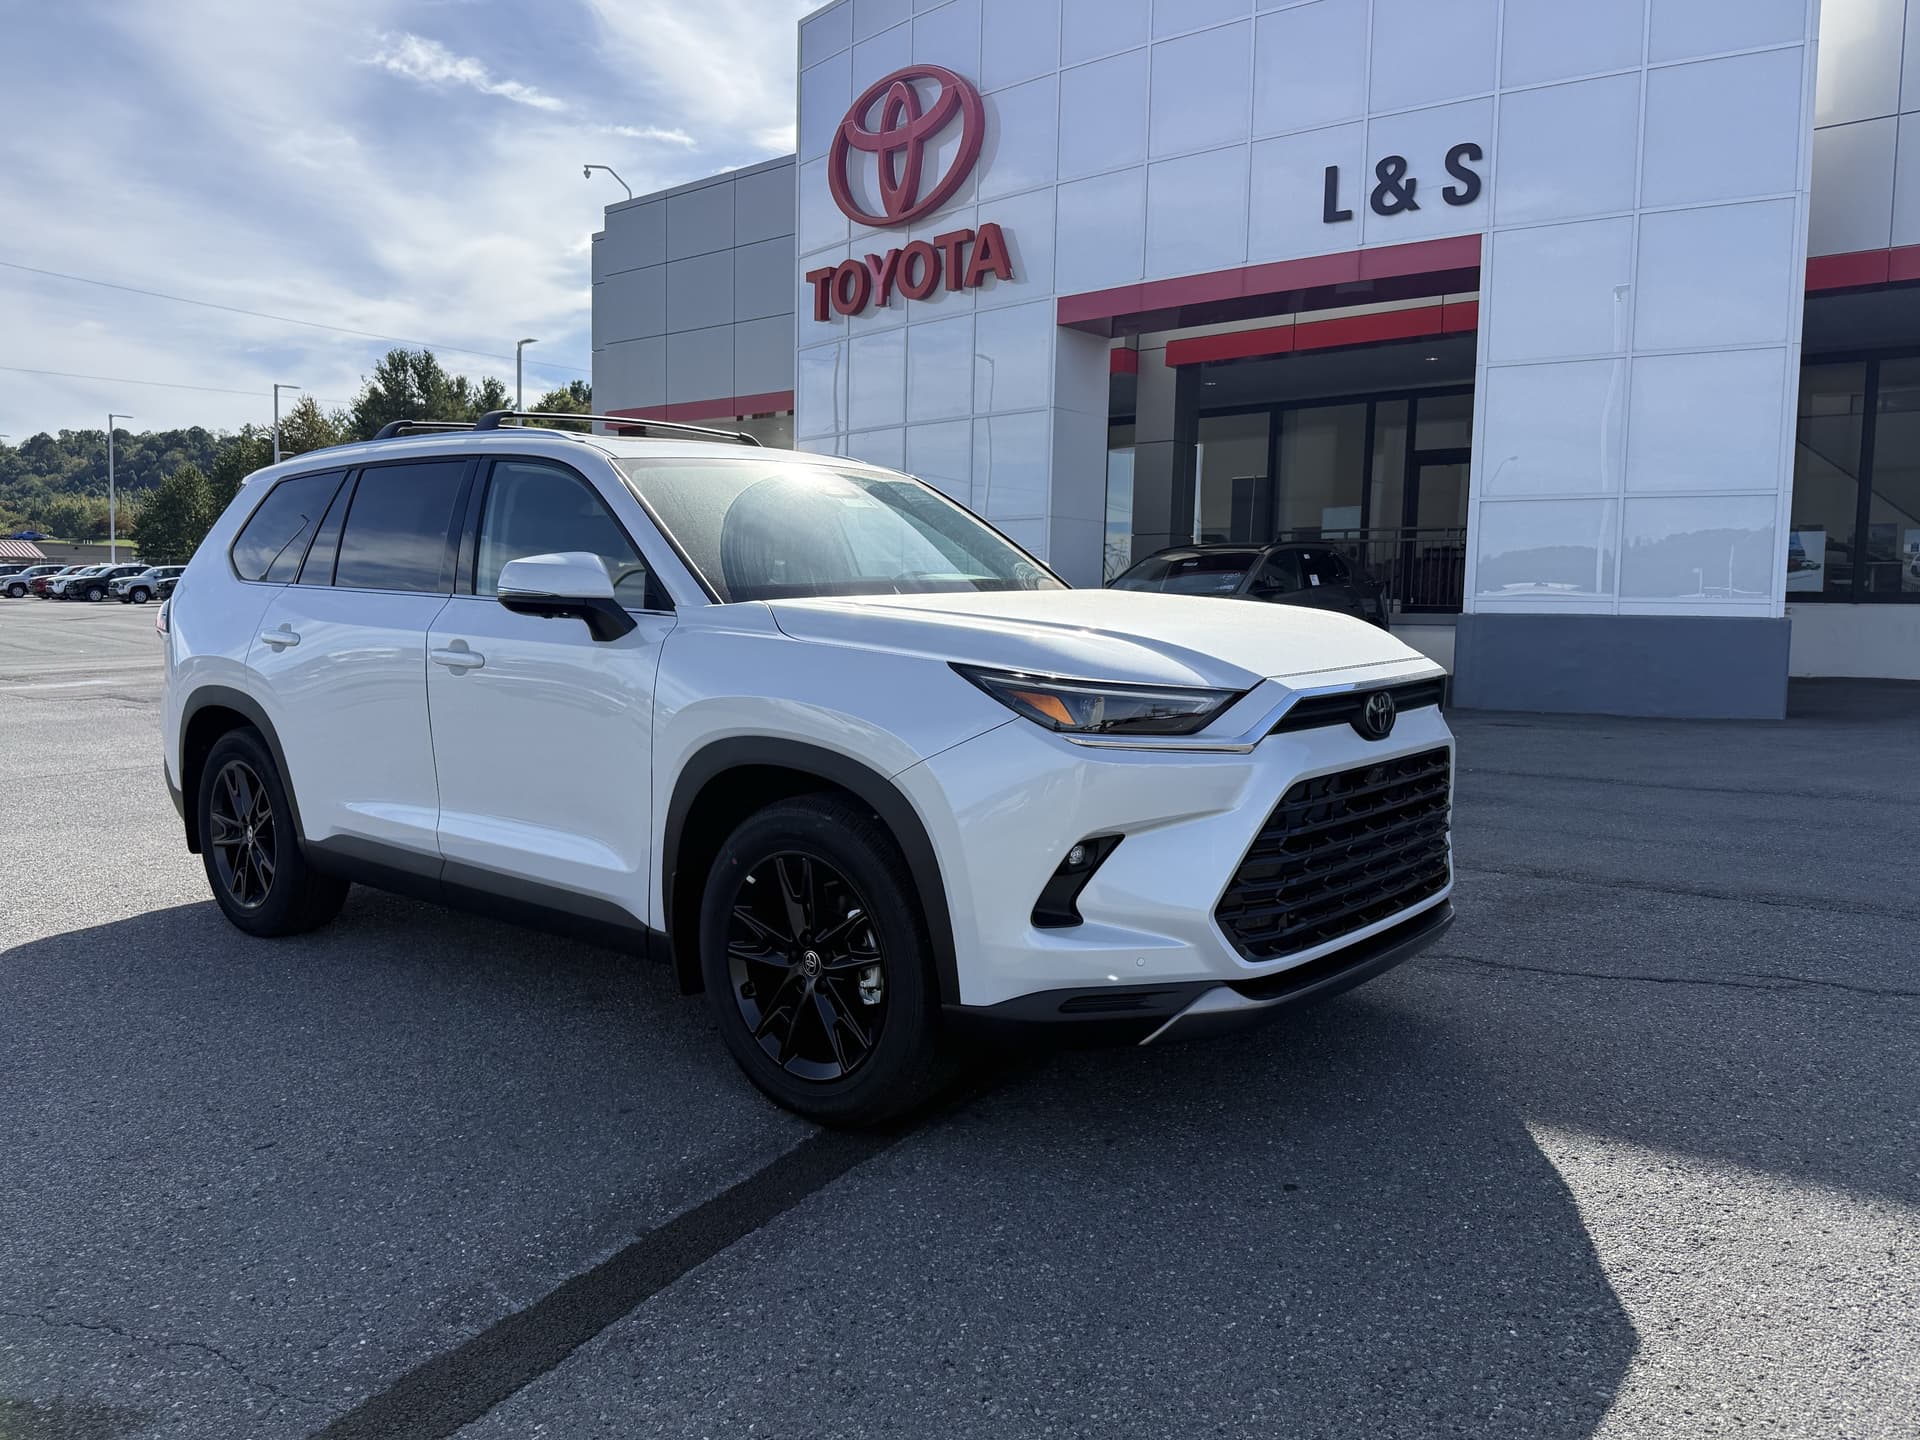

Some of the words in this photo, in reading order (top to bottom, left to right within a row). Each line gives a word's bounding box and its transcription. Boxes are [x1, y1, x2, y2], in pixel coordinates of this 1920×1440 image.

[1323, 165, 1353, 223] L
[1370, 155, 1420, 216] &
[1442, 142, 1483, 206] S
[806, 222, 1014, 321] TOYOTA
